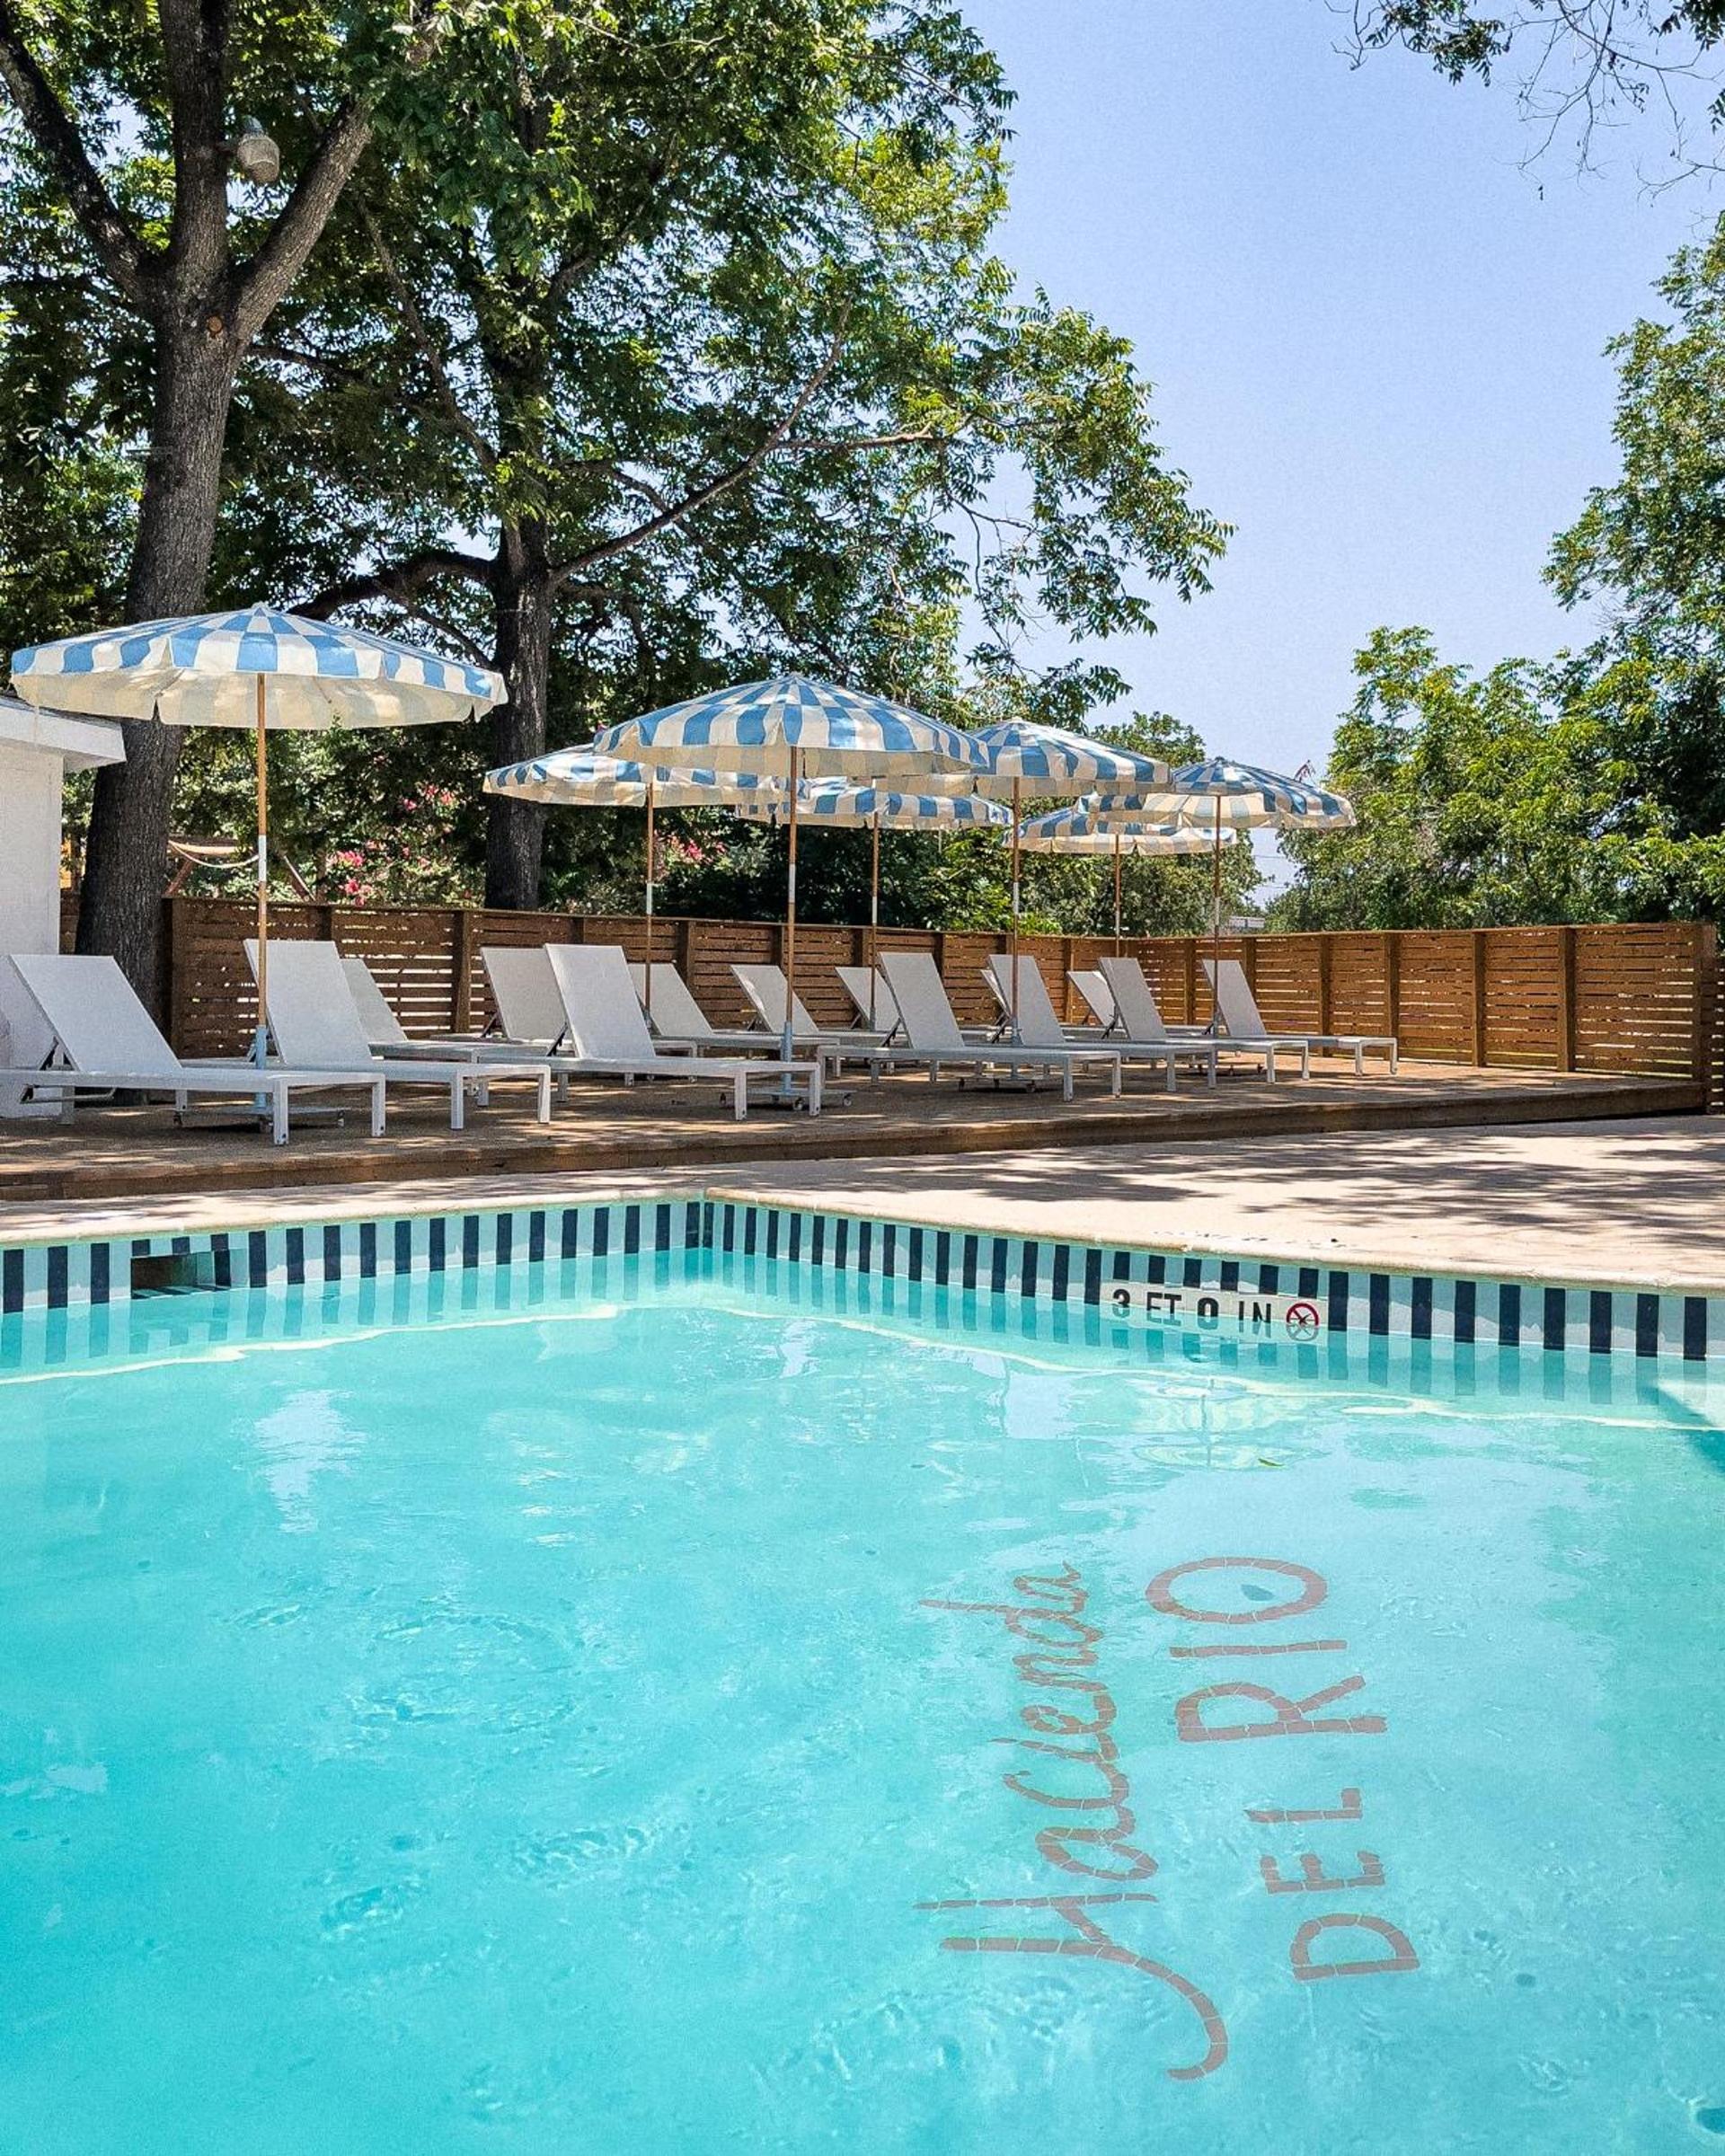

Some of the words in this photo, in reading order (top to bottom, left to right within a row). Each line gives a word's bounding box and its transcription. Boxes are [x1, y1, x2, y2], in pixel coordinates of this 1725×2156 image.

[1112, 1288, 1131, 1312] 3
[1146, 1291, 1182, 1316] FT
[1238, 1300, 1272, 1325] IN
[1145, 1556, 1389, 1743] RIO
[913, 1561, 1229, 2081] Hacienda
[1243, 1787, 1421, 1983] DEL
